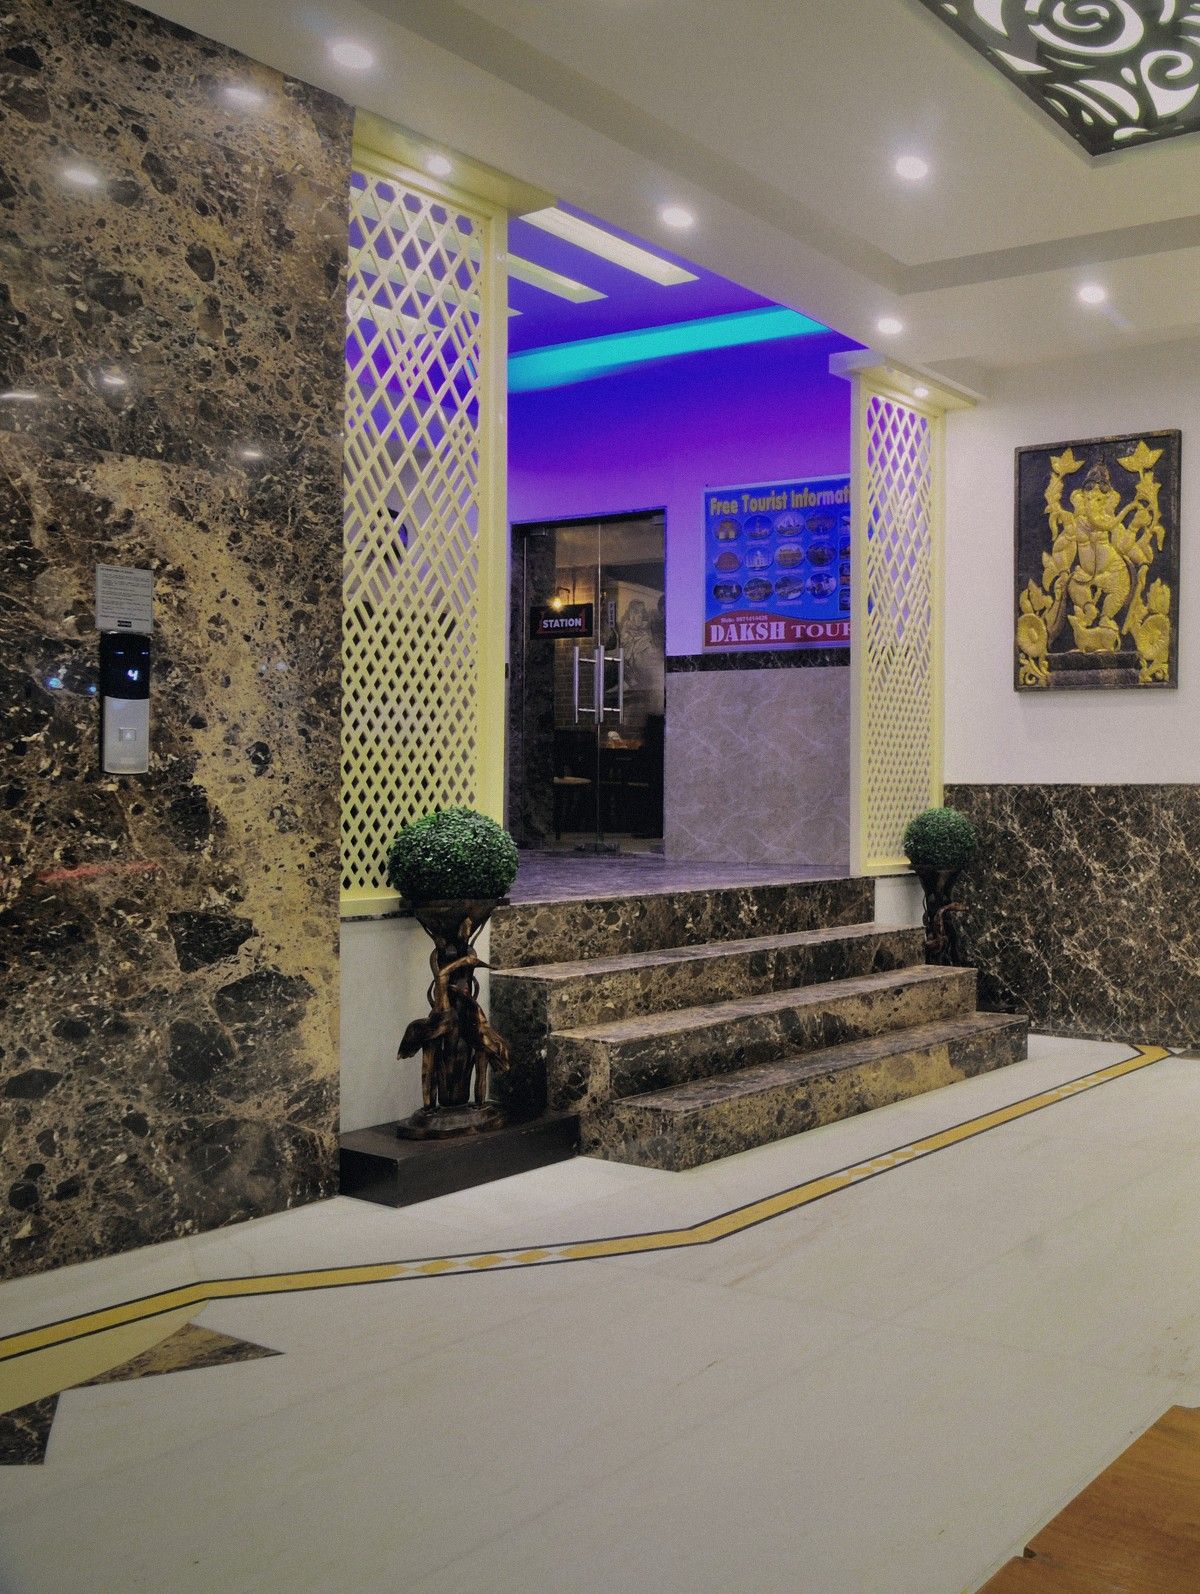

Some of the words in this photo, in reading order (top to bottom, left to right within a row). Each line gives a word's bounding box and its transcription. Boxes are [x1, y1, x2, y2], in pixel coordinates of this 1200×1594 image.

[710, 497, 738, 516] Free
[742, 490, 787, 513] Tourist
[542, 617, 582, 628] STATION
[710, 621, 785, 643] DAKSH
